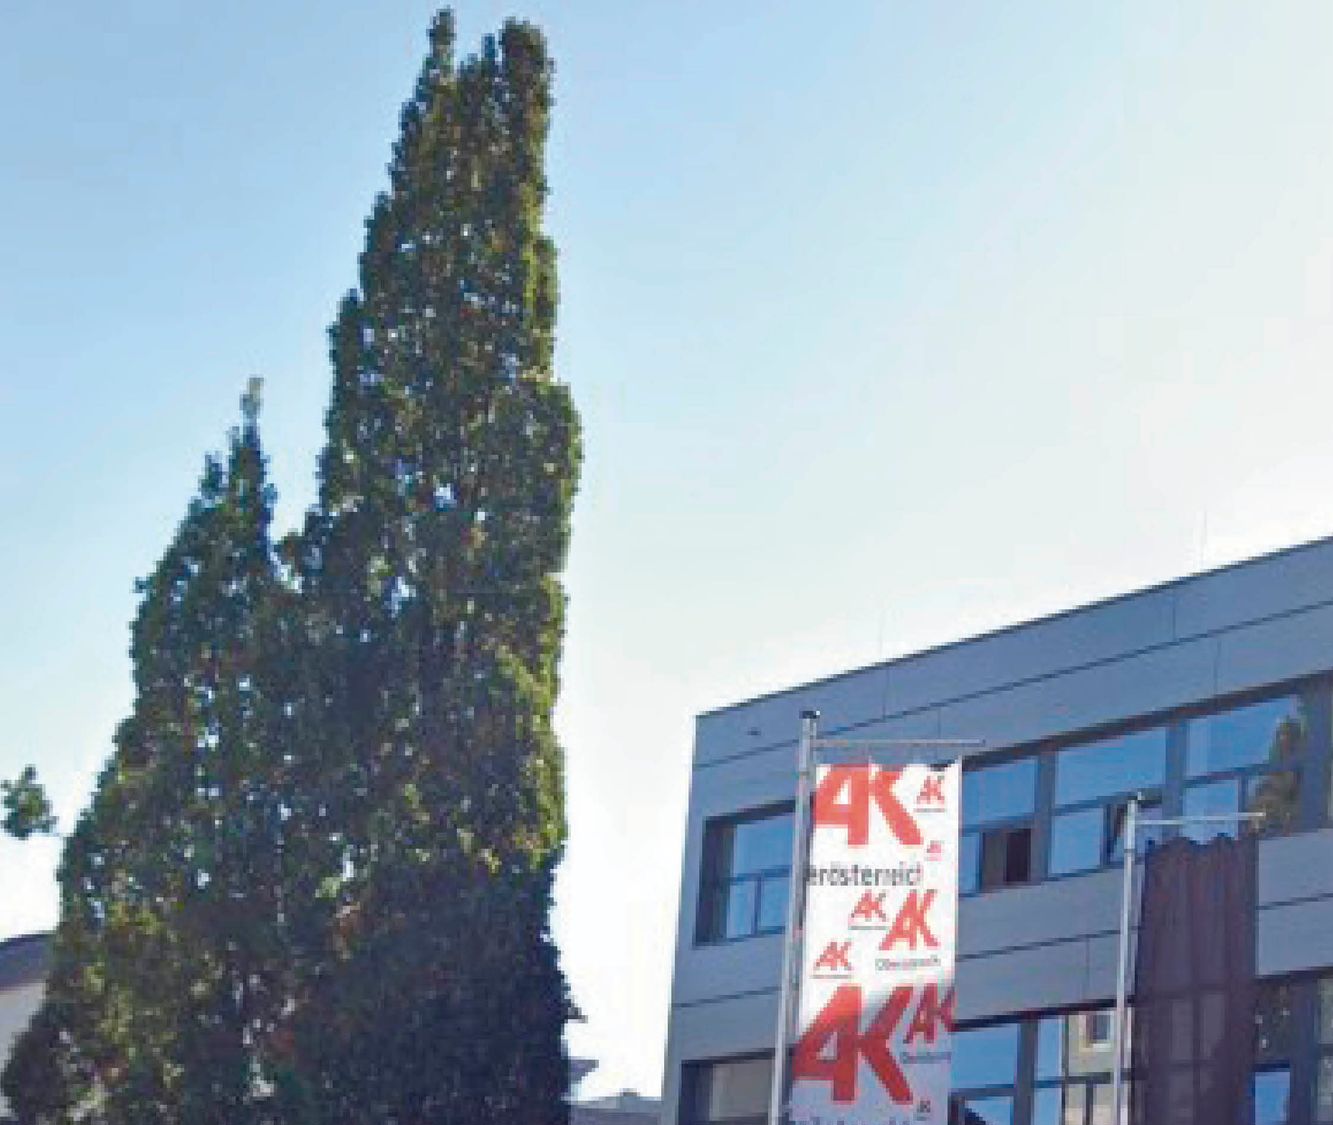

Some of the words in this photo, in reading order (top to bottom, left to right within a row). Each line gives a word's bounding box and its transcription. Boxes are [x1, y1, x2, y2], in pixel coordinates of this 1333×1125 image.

[814, 764, 924, 845] AK
[850, 889, 888, 922] AK
[880, 889, 940, 950] AK
[813, 941, 853, 971] AK
[792, 986, 914, 1104] AK
